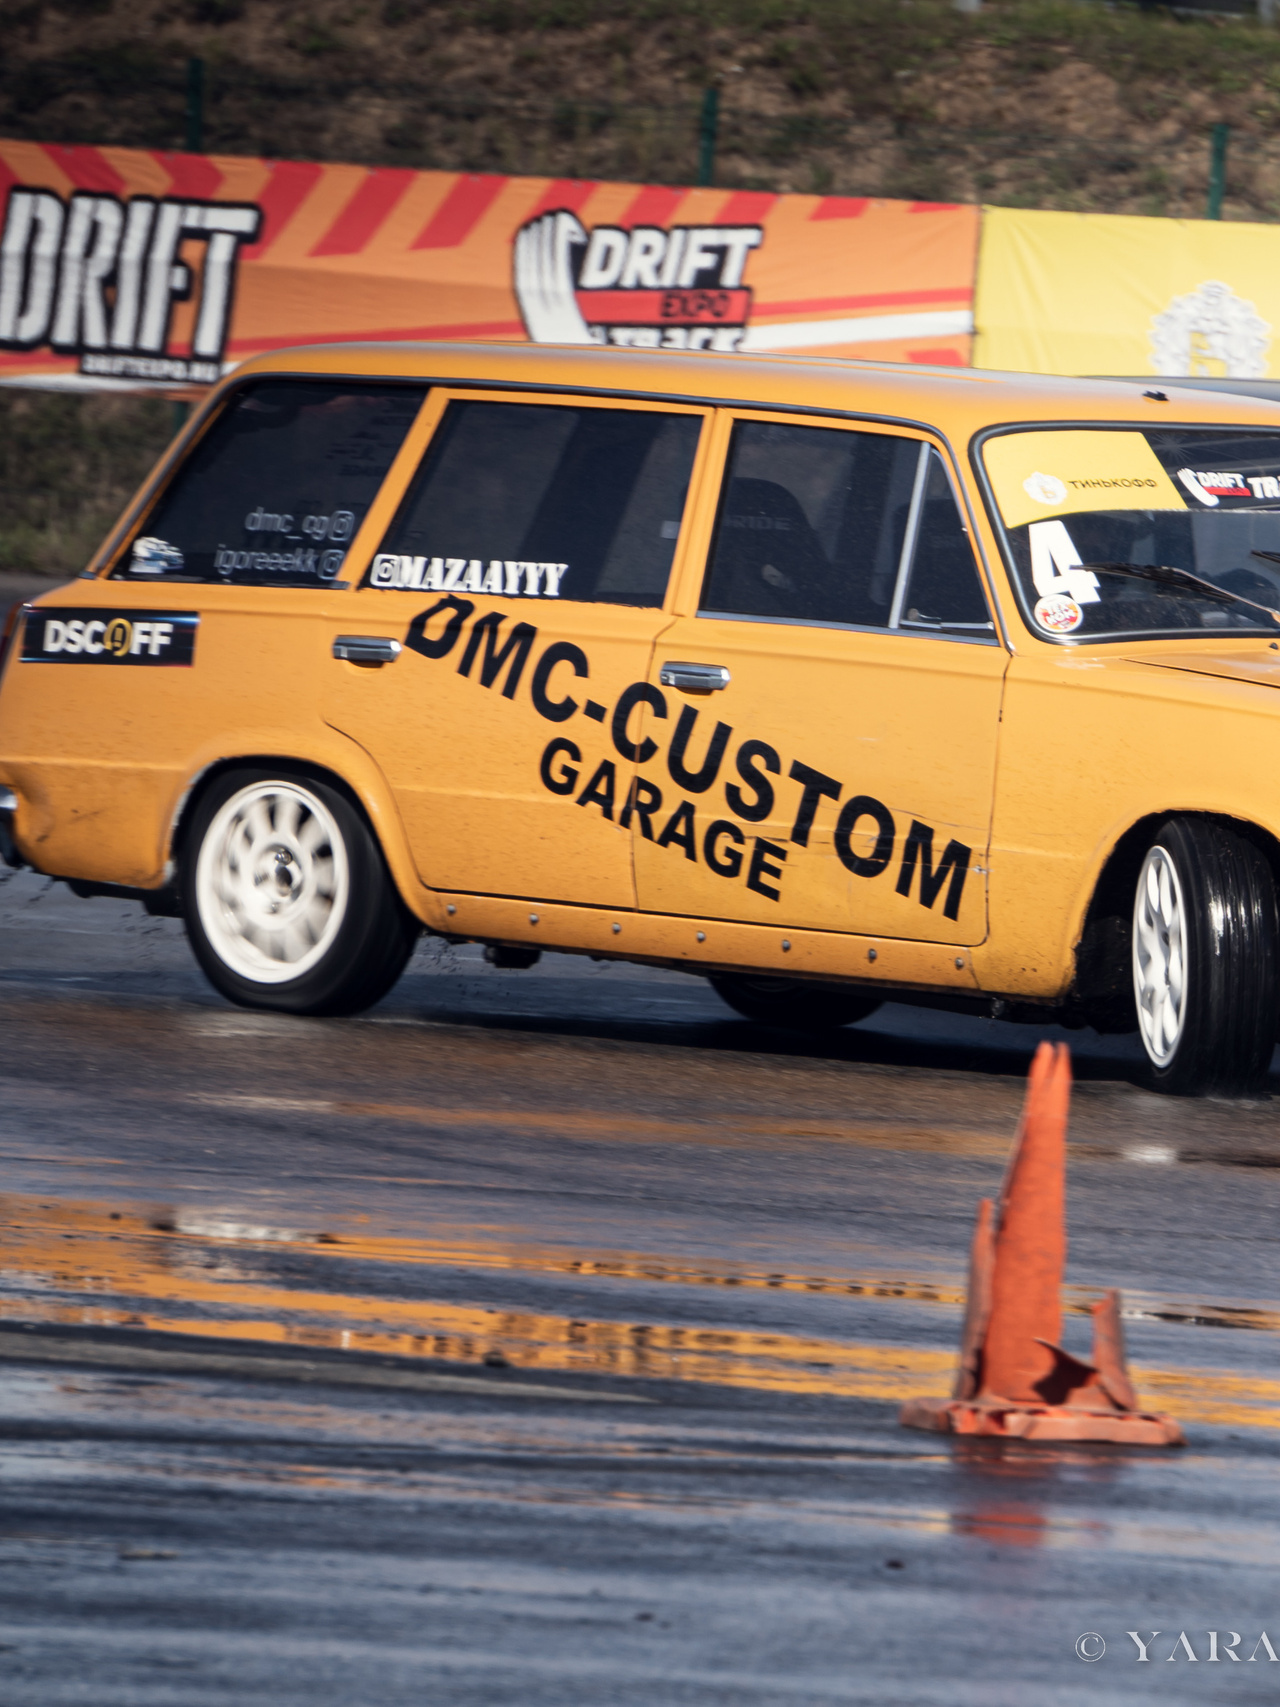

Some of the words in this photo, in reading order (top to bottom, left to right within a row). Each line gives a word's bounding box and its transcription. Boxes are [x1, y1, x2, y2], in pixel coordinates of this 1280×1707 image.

[0, 189, 262, 357] DRIFT
[578, 226, 762, 288] DRIFT
[660, 293, 729, 318] EXPO
[1068, 478, 1157, 489] ТИНЬКОФФ
[1196, 471, 1245, 488] DRIFT
[1028, 520, 1101, 604] 4
[403, 594, 972, 922] DMC-CUSTOM
[540, 736, 788, 902] GARAGE
